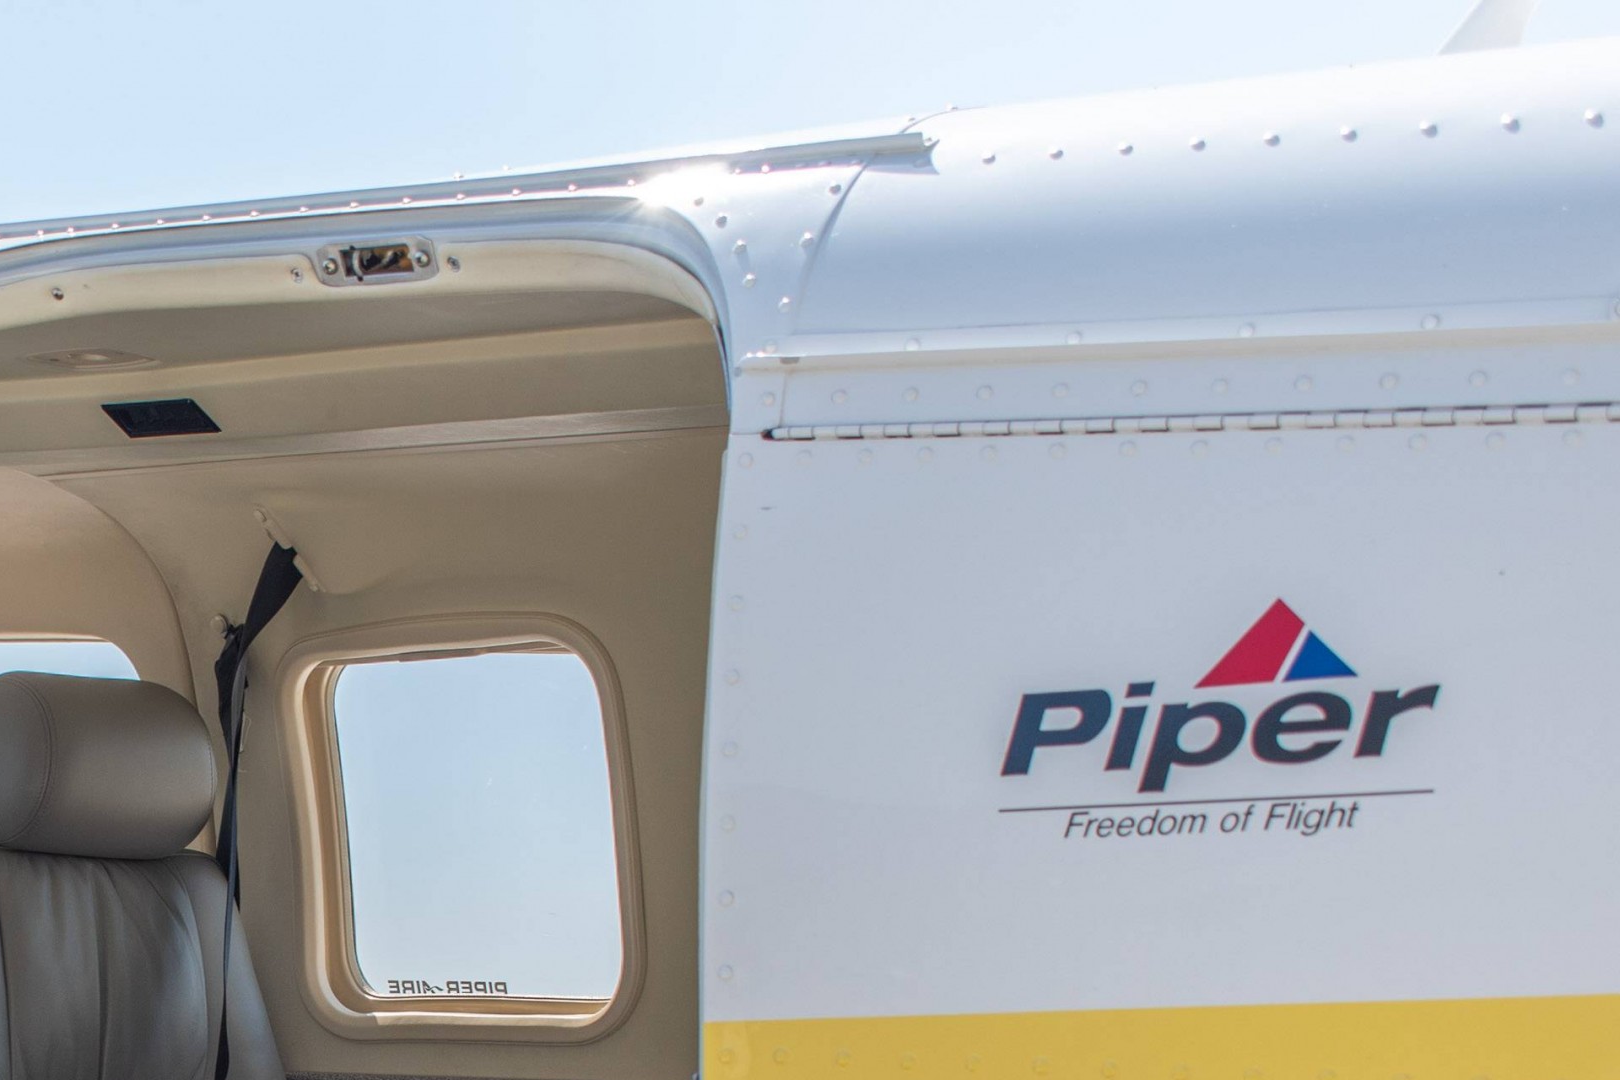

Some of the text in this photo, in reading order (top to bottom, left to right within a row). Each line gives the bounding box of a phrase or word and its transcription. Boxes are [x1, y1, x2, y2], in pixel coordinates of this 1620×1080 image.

[1000, 681, 1441, 793] Piper
[1063, 801, 1359, 838] Freedom of Flight
